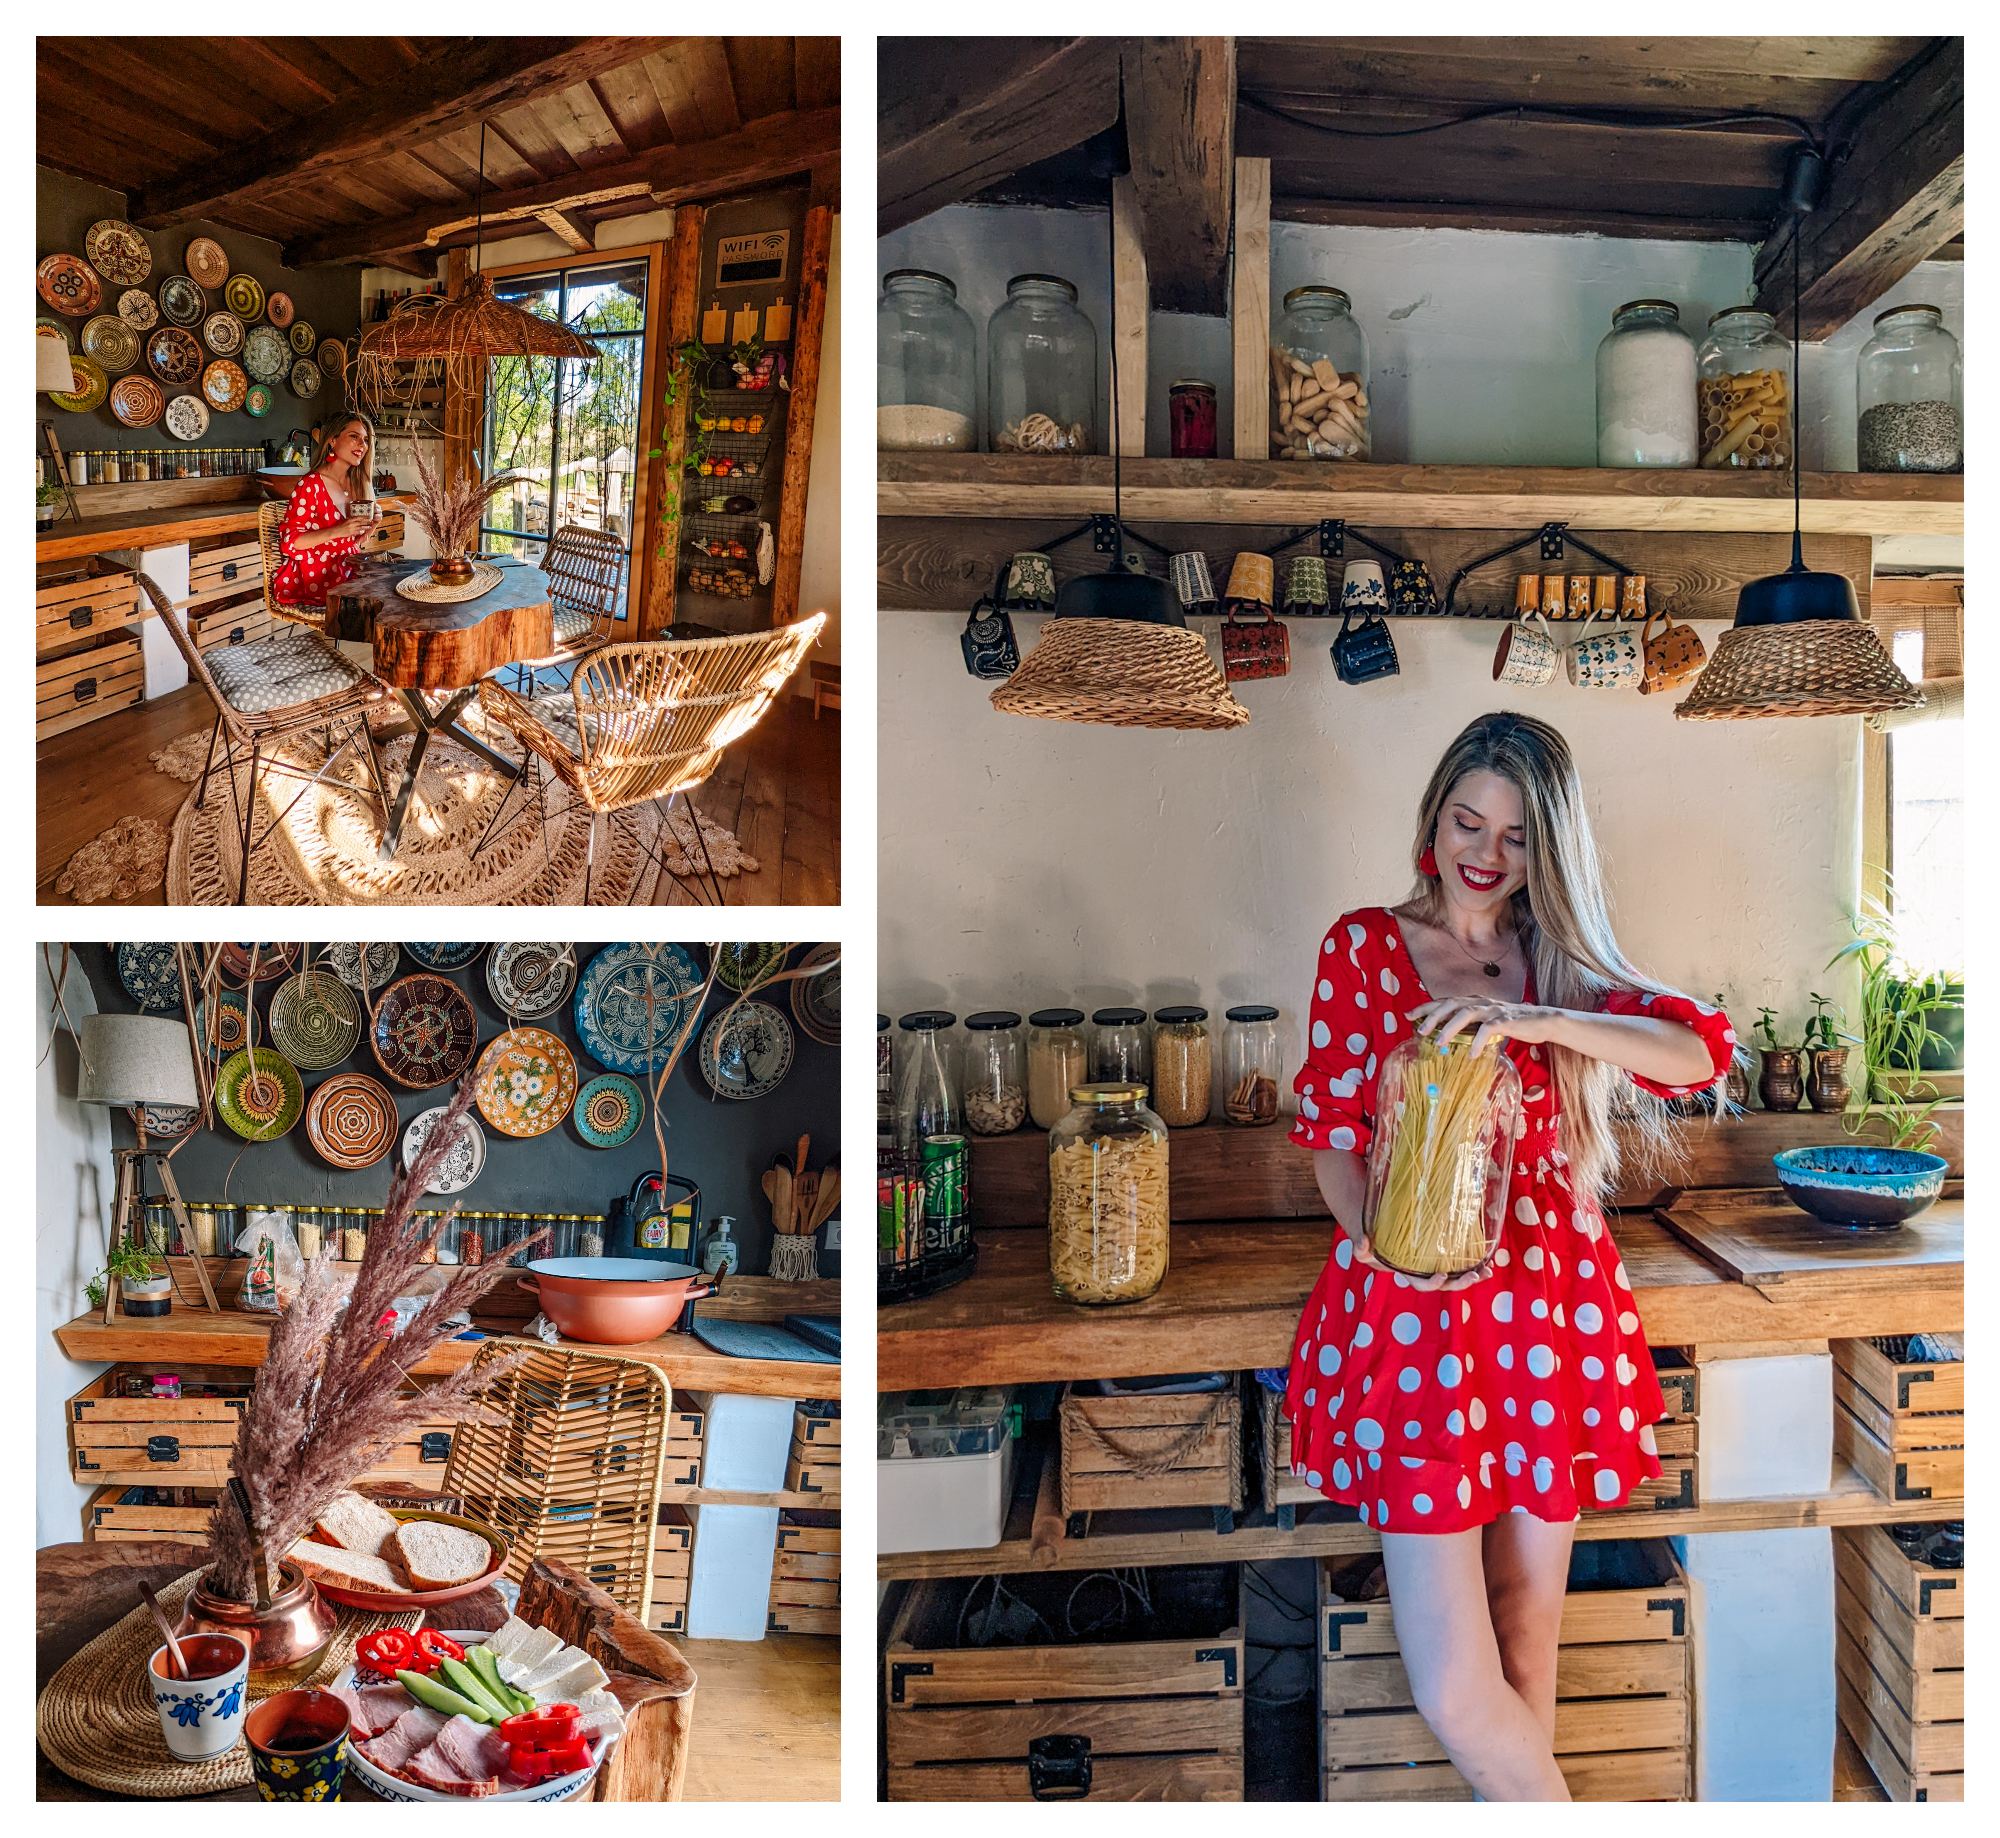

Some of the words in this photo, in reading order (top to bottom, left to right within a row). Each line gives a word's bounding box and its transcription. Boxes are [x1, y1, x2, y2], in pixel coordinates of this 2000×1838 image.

[724, 240, 758, 253] WIFI
[723, 250, 784, 262] PASSWORD
[646, 1229, 662, 1238] FAIRY
